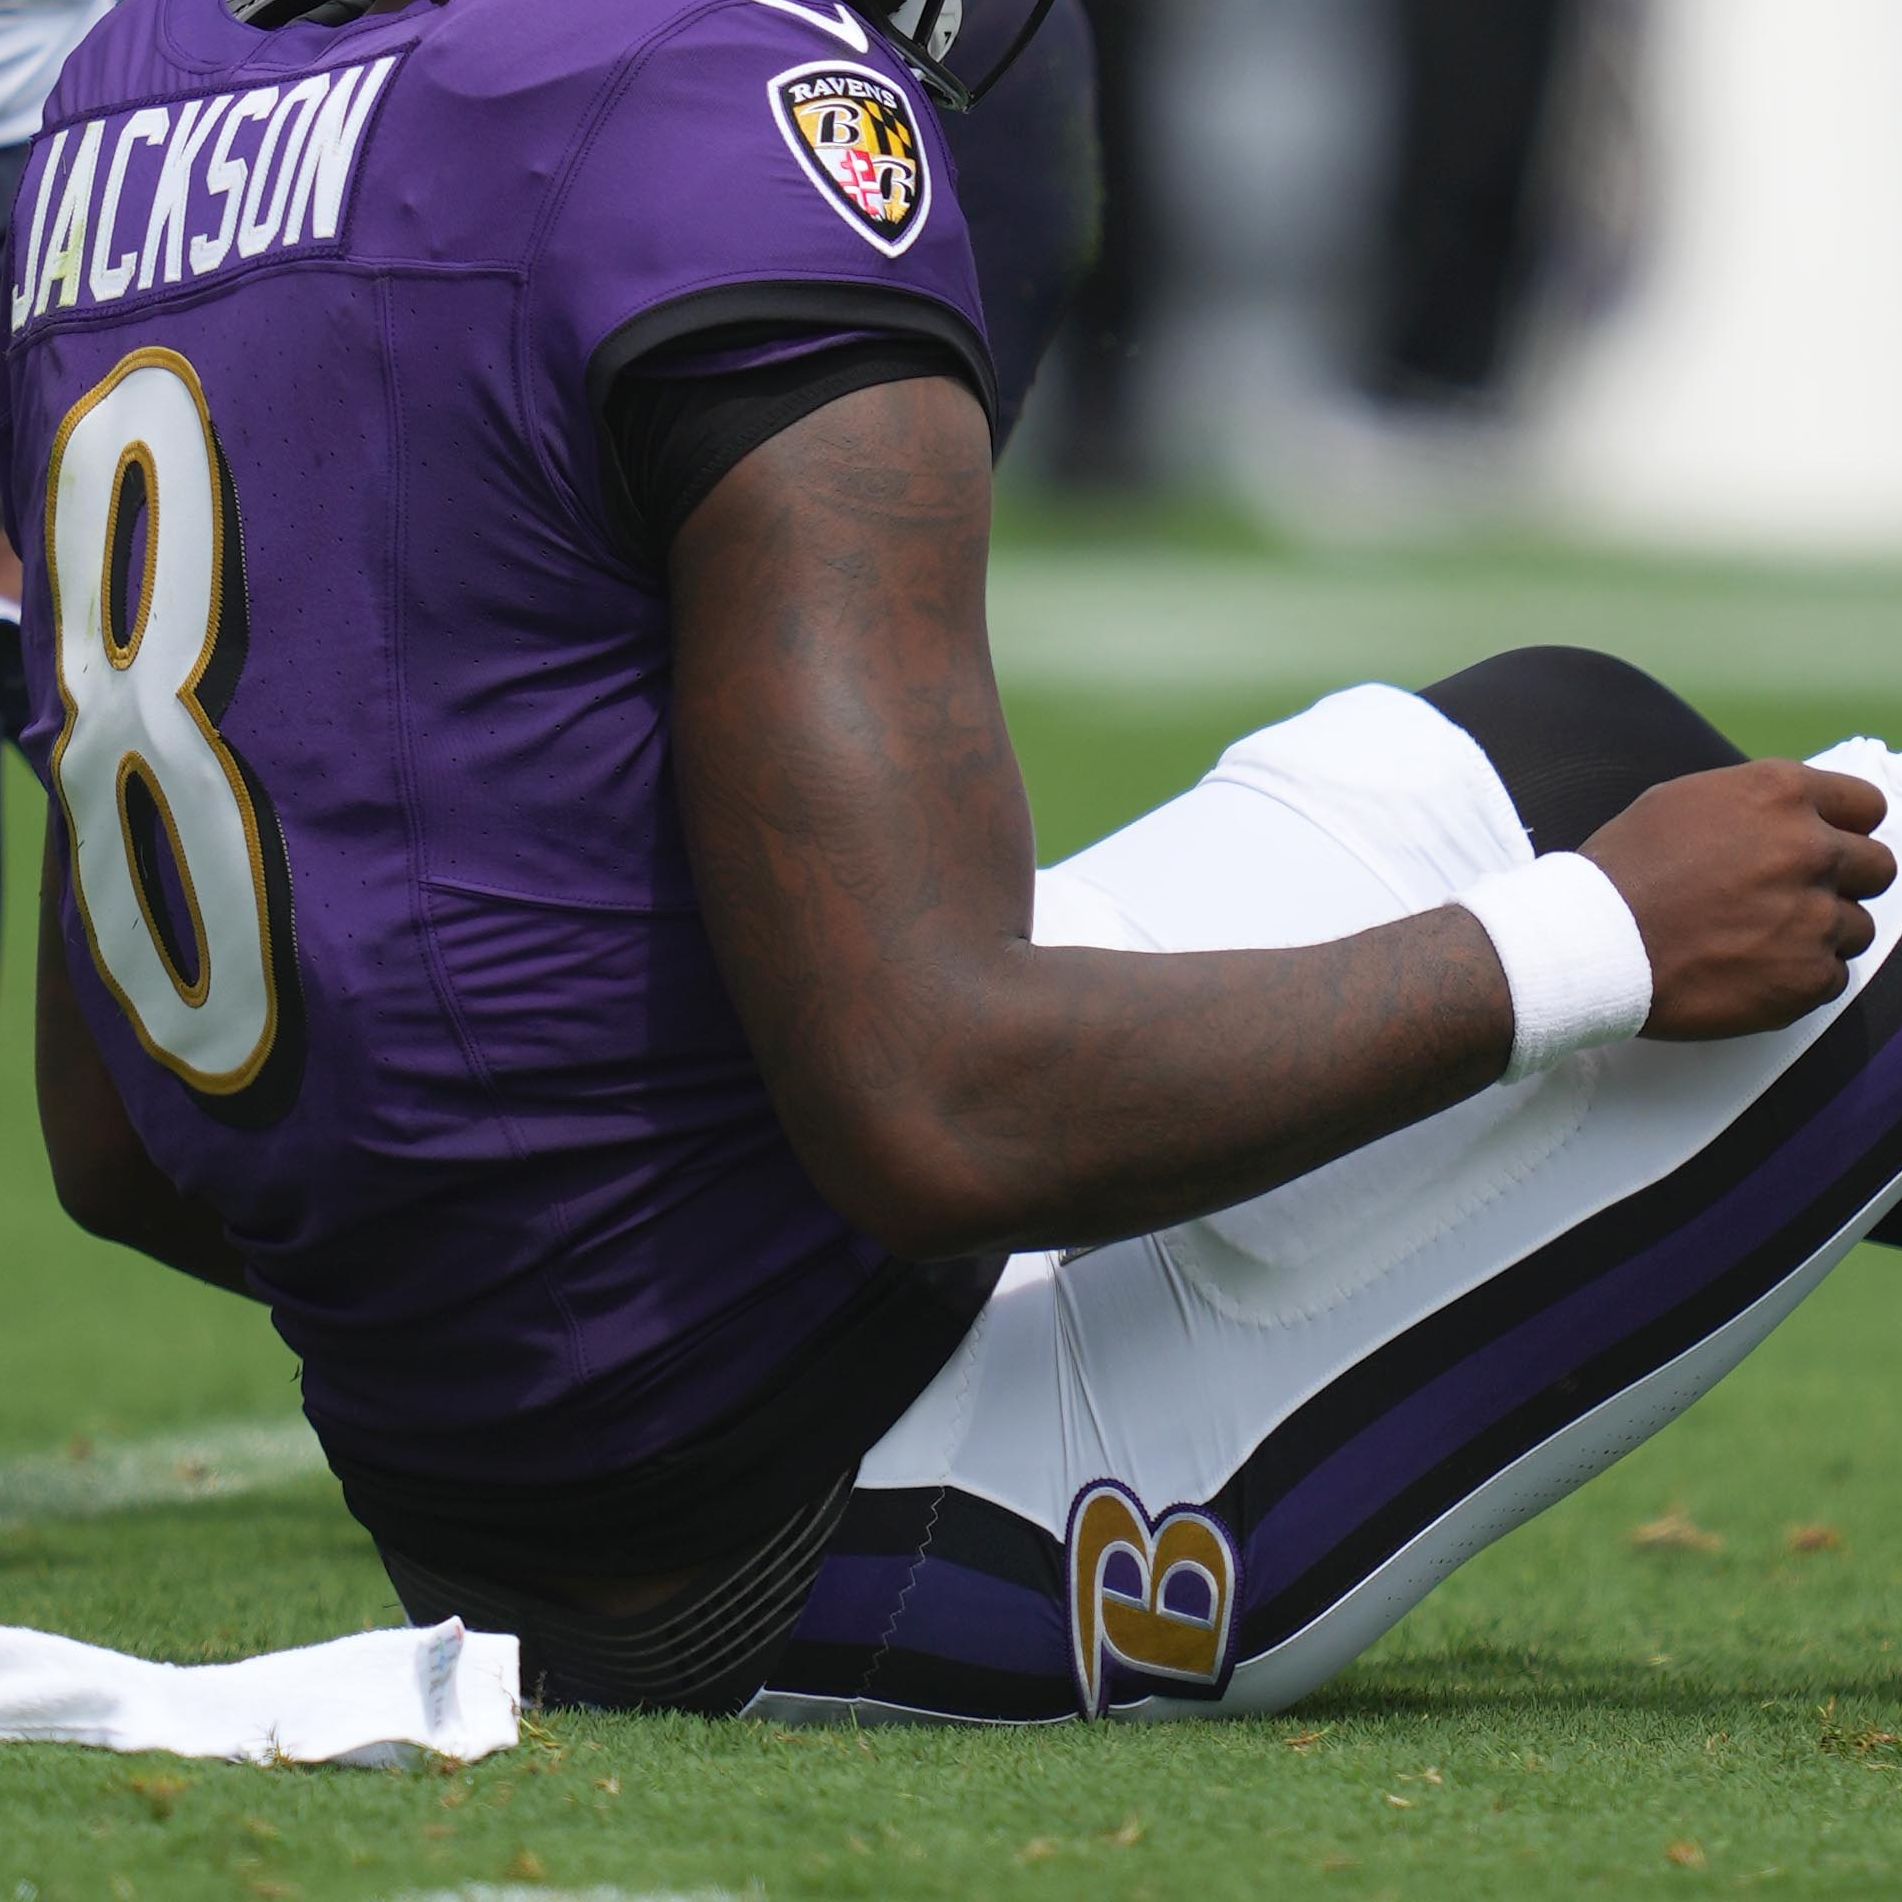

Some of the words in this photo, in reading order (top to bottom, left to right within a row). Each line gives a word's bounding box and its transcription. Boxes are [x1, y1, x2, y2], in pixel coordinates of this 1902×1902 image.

[11, 56, 397, 334] JACKSON
[788, 77, 898, 110] RAVENS
[45, 345, 286, 1096] 8
[1064, 1478, 1245, 1720] B
